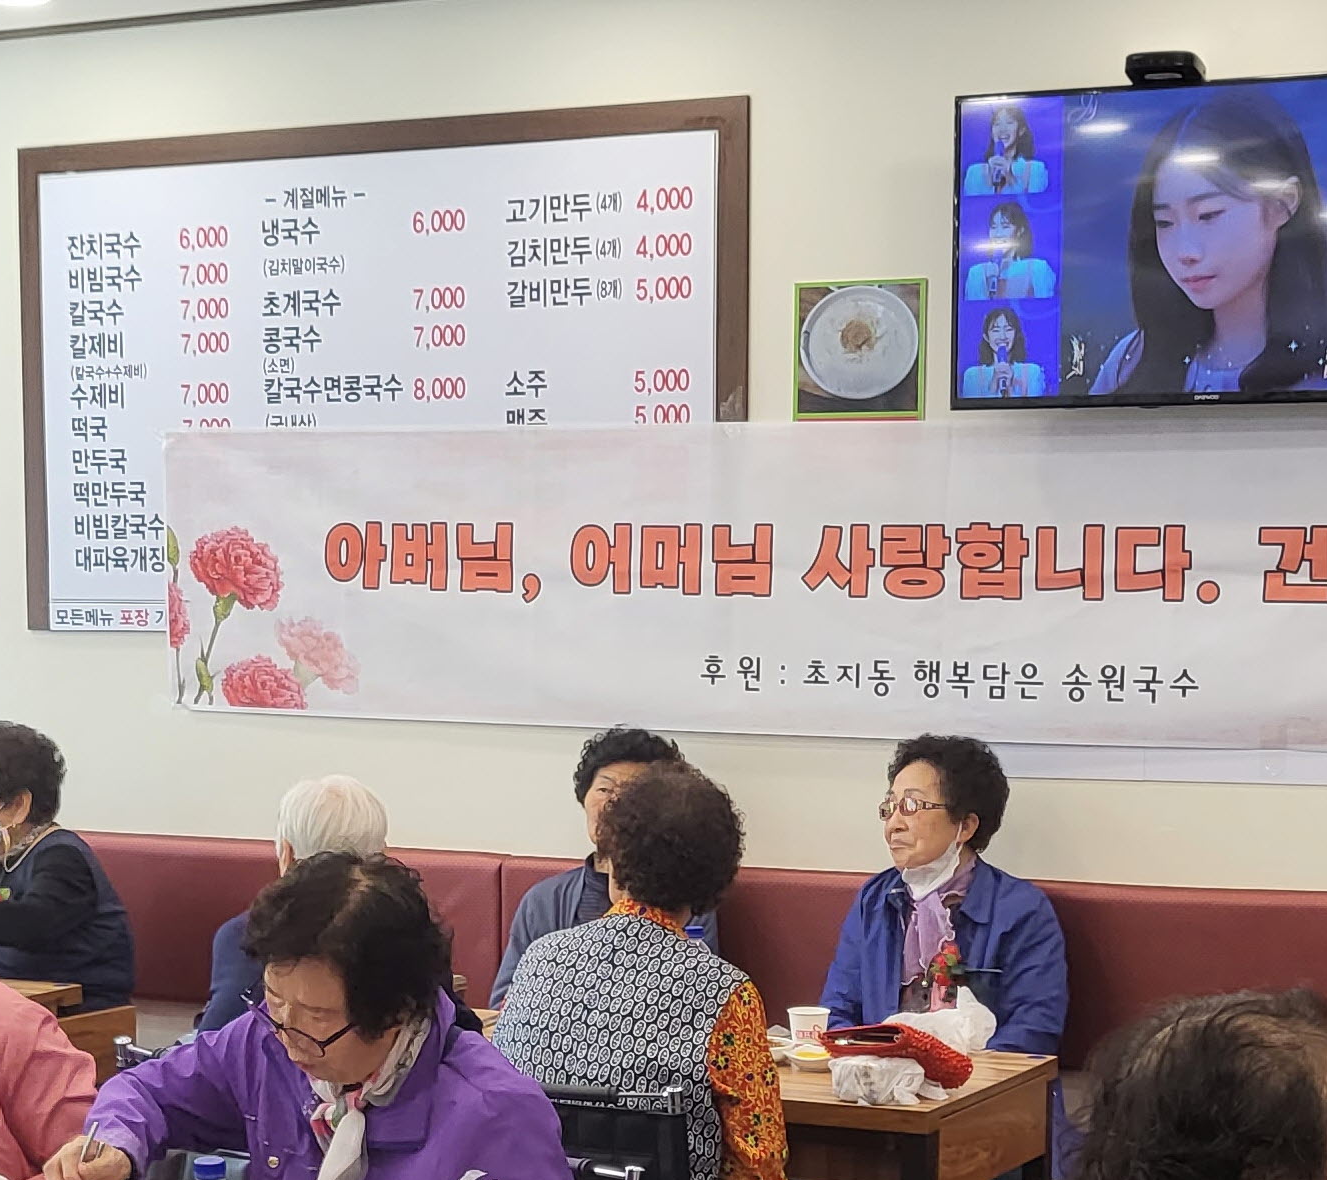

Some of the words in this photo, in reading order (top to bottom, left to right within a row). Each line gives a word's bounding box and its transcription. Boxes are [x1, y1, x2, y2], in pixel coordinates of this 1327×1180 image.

[284, 186, 347, 209] 계절메뉴
[506, 194, 592, 224] 고기만두
[637, 186, 692, 214] 4,000
[262, 217, 320, 246] 냉국수
[413, 209, 465, 235] 6,000
[68, 232, 141, 260] 잔치국수
[180, 226, 228, 249] 6,000
[508, 237, 592, 267] 김치만두
[636, 233, 691, 260] 4,000
[69, 265, 142, 294] 비빔국수
[180, 263, 228, 287] 7,000
[264, 255, 344, 277] (김치말이국수)
[262, 289, 341, 317] 초계국수
[414, 286, 465, 312] 7,000
[507, 278, 592, 308] 갈비만두
[636, 276, 691, 303] 5,000
[70, 299, 124, 326] 칼국수
[181, 298, 228, 322] 7,000
[70, 332, 123, 359] 칼제비
[182, 332, 229, 356] 7,000
[263, 325, 322, 354] 콩국수
[414, 324, 465, 350] 7,000
[263, 358, 294, 375] (소면)
[70, 382, 124, 410] 수제비
[181, 383, 229, 406] 7,000
[264, 372, 403, 404] 칼국수면콩국수
[414, 377, 465, 402] 8,000
[505, 371, 547, 398] 소주
[634, 369, 689, 395] 5,000
[72, 416, 107, 442] 떡국
[72, 449, 127, 474] 만두국
[74, 482, 146, 507] 떡만두국
[75, 514, 164, 540] 비빔칼국수
[325, 521, 541, 603] 아버님,
[570, 523, 773, 597] 어머님
[801, 522, 1220, 604] 사랑합니다.
[55, 609, 114, 626] 모든메뉴
[120, 609, 149, 627] 포장
[803, 660, 895, 696] 초지동
[914, 660, 1044, 699] 행복담은
[1062, 664, 1199, 703] 송원국수
